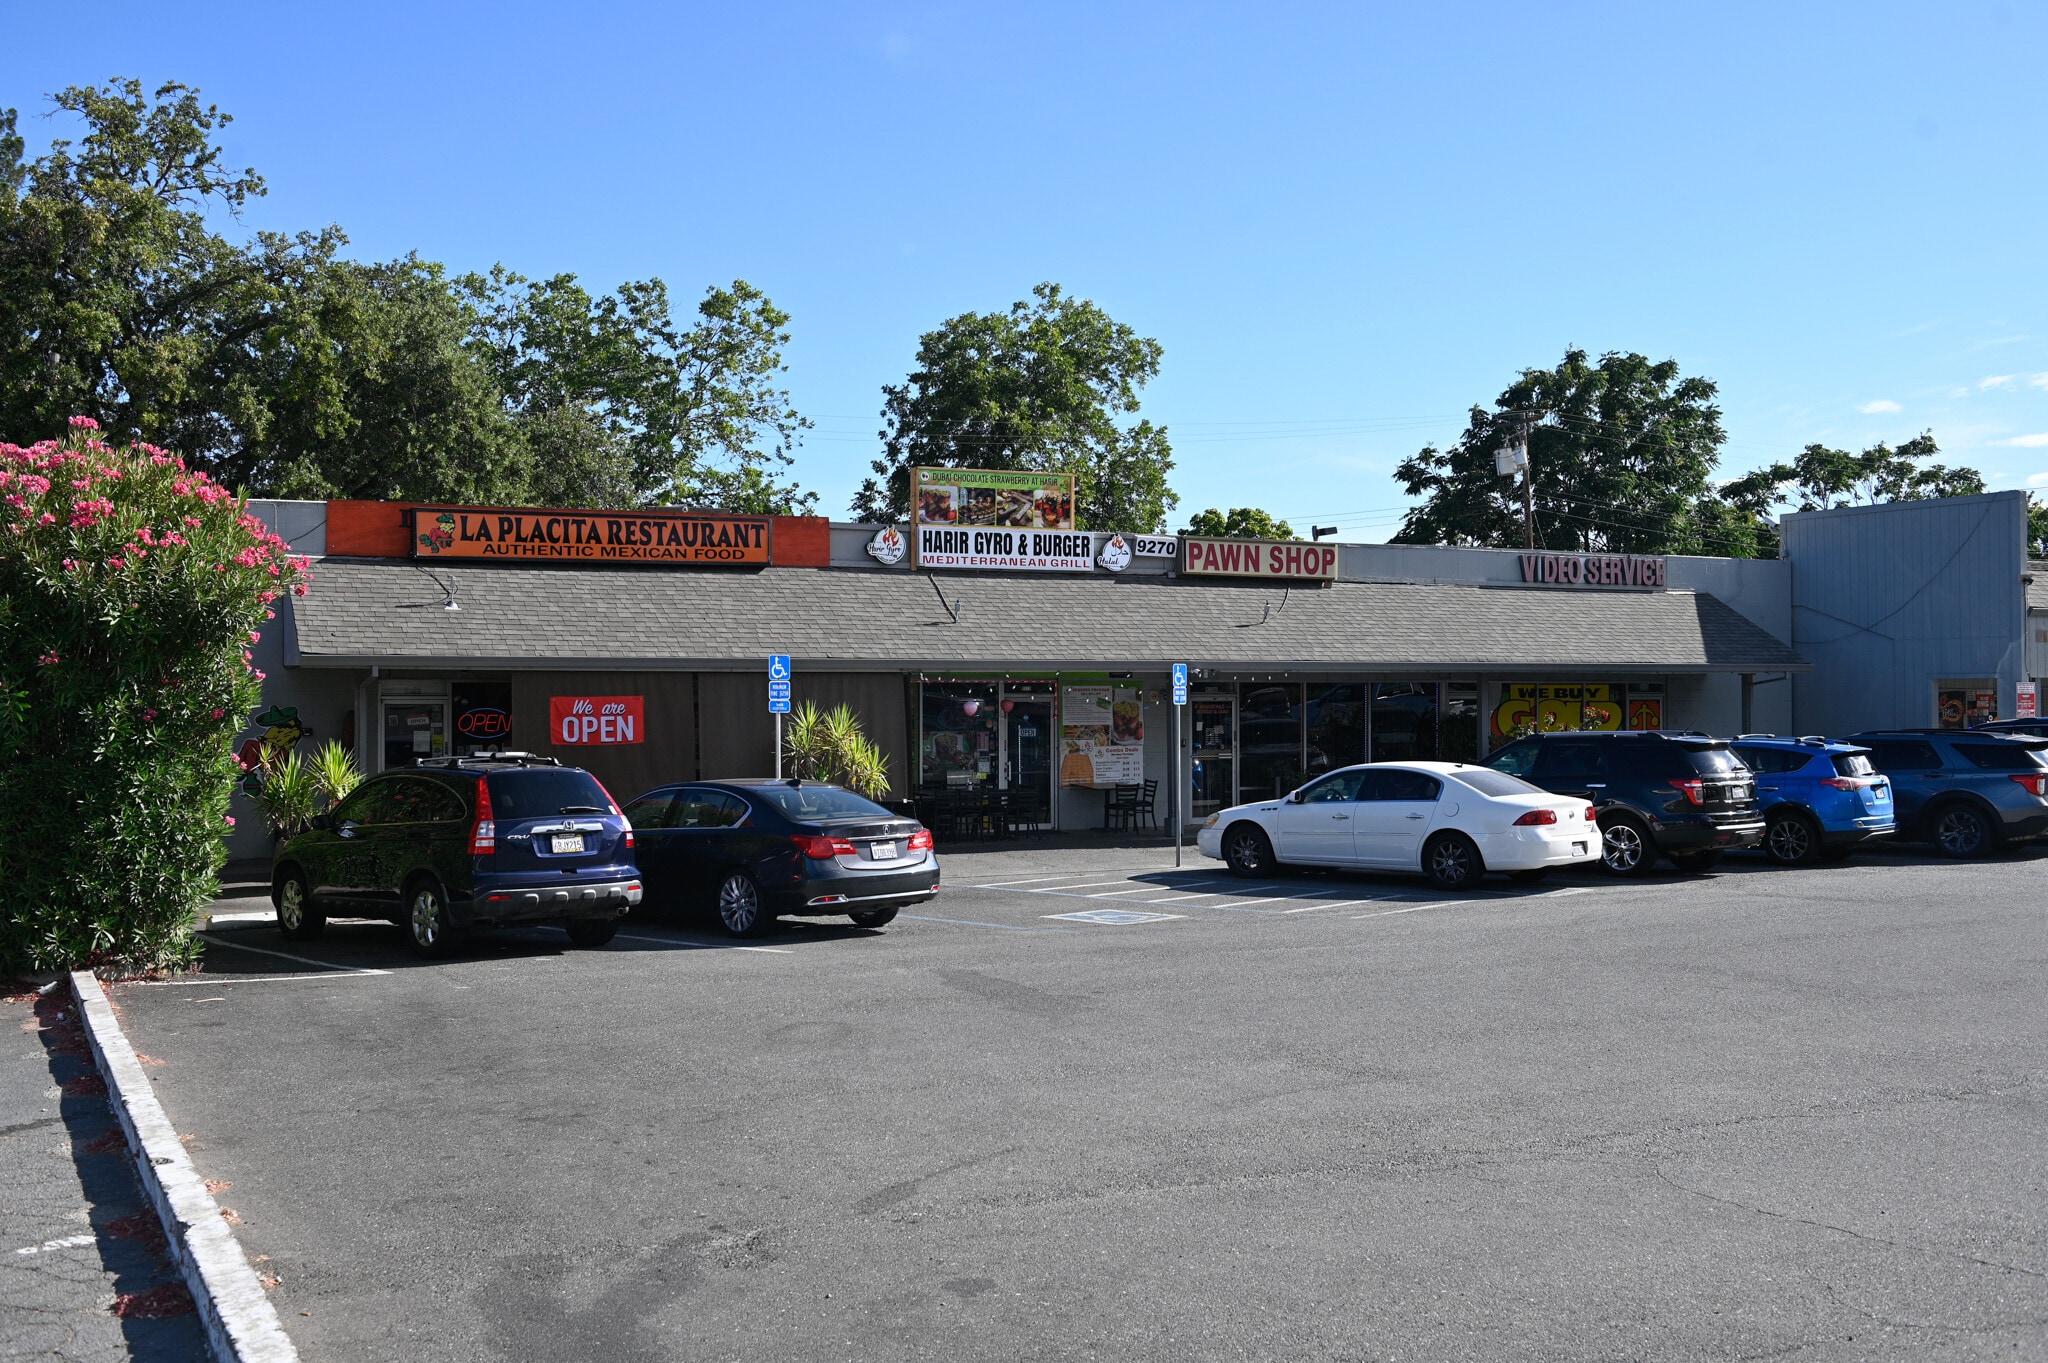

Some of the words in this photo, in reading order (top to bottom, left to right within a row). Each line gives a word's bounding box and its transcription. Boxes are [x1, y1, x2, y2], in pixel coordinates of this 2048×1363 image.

[932, 473, 952, 482] DUBAI
[953, 474, 989, 484] CHOCOLATE
[989, 475, 1030, 485] STRAWBERRY
[1031, 477, 1039, 486] AT
[460, 515, 493, 542] LA
[498, 516, 603, 544] PLACITA
[607, 519, 766, 548] RESTAURANT
[483, 544, 594, 557] AUTHENTIC
[601, 546, 687, 559] MEXICAN
[694, 549, 745, 560] FOOD
[922, 530, 969, 554] HARIR
[974, 532, 1013, 556] GYRO
[1018, 533, 1028, 556] &
[1033, 533, 1091, 558] BURGER
[1137, 539, 1176, 555] 9270
[923, 555, 1047, 567] MEDITERRANEAN
[1050, 558, 1090, 568] GRILL
[1097, 556, 1119, 565] Halal
[1188, 542, 1261, 573] PAWN
[1269, 546, 1335, 575] SHOP
[1585, 557, 1665, 586] SERVICE
[1517, 687, 1552, 699] WE
[1553, 687, 1603, 699] BUY
[572, 699, 594, 715] We
[601, 702, 626, 715] are
[457, 713, 513, 733] OPEN
[562, 715, 634, 743] OPEN
[1020, 728, 1035, 736] OPEN
